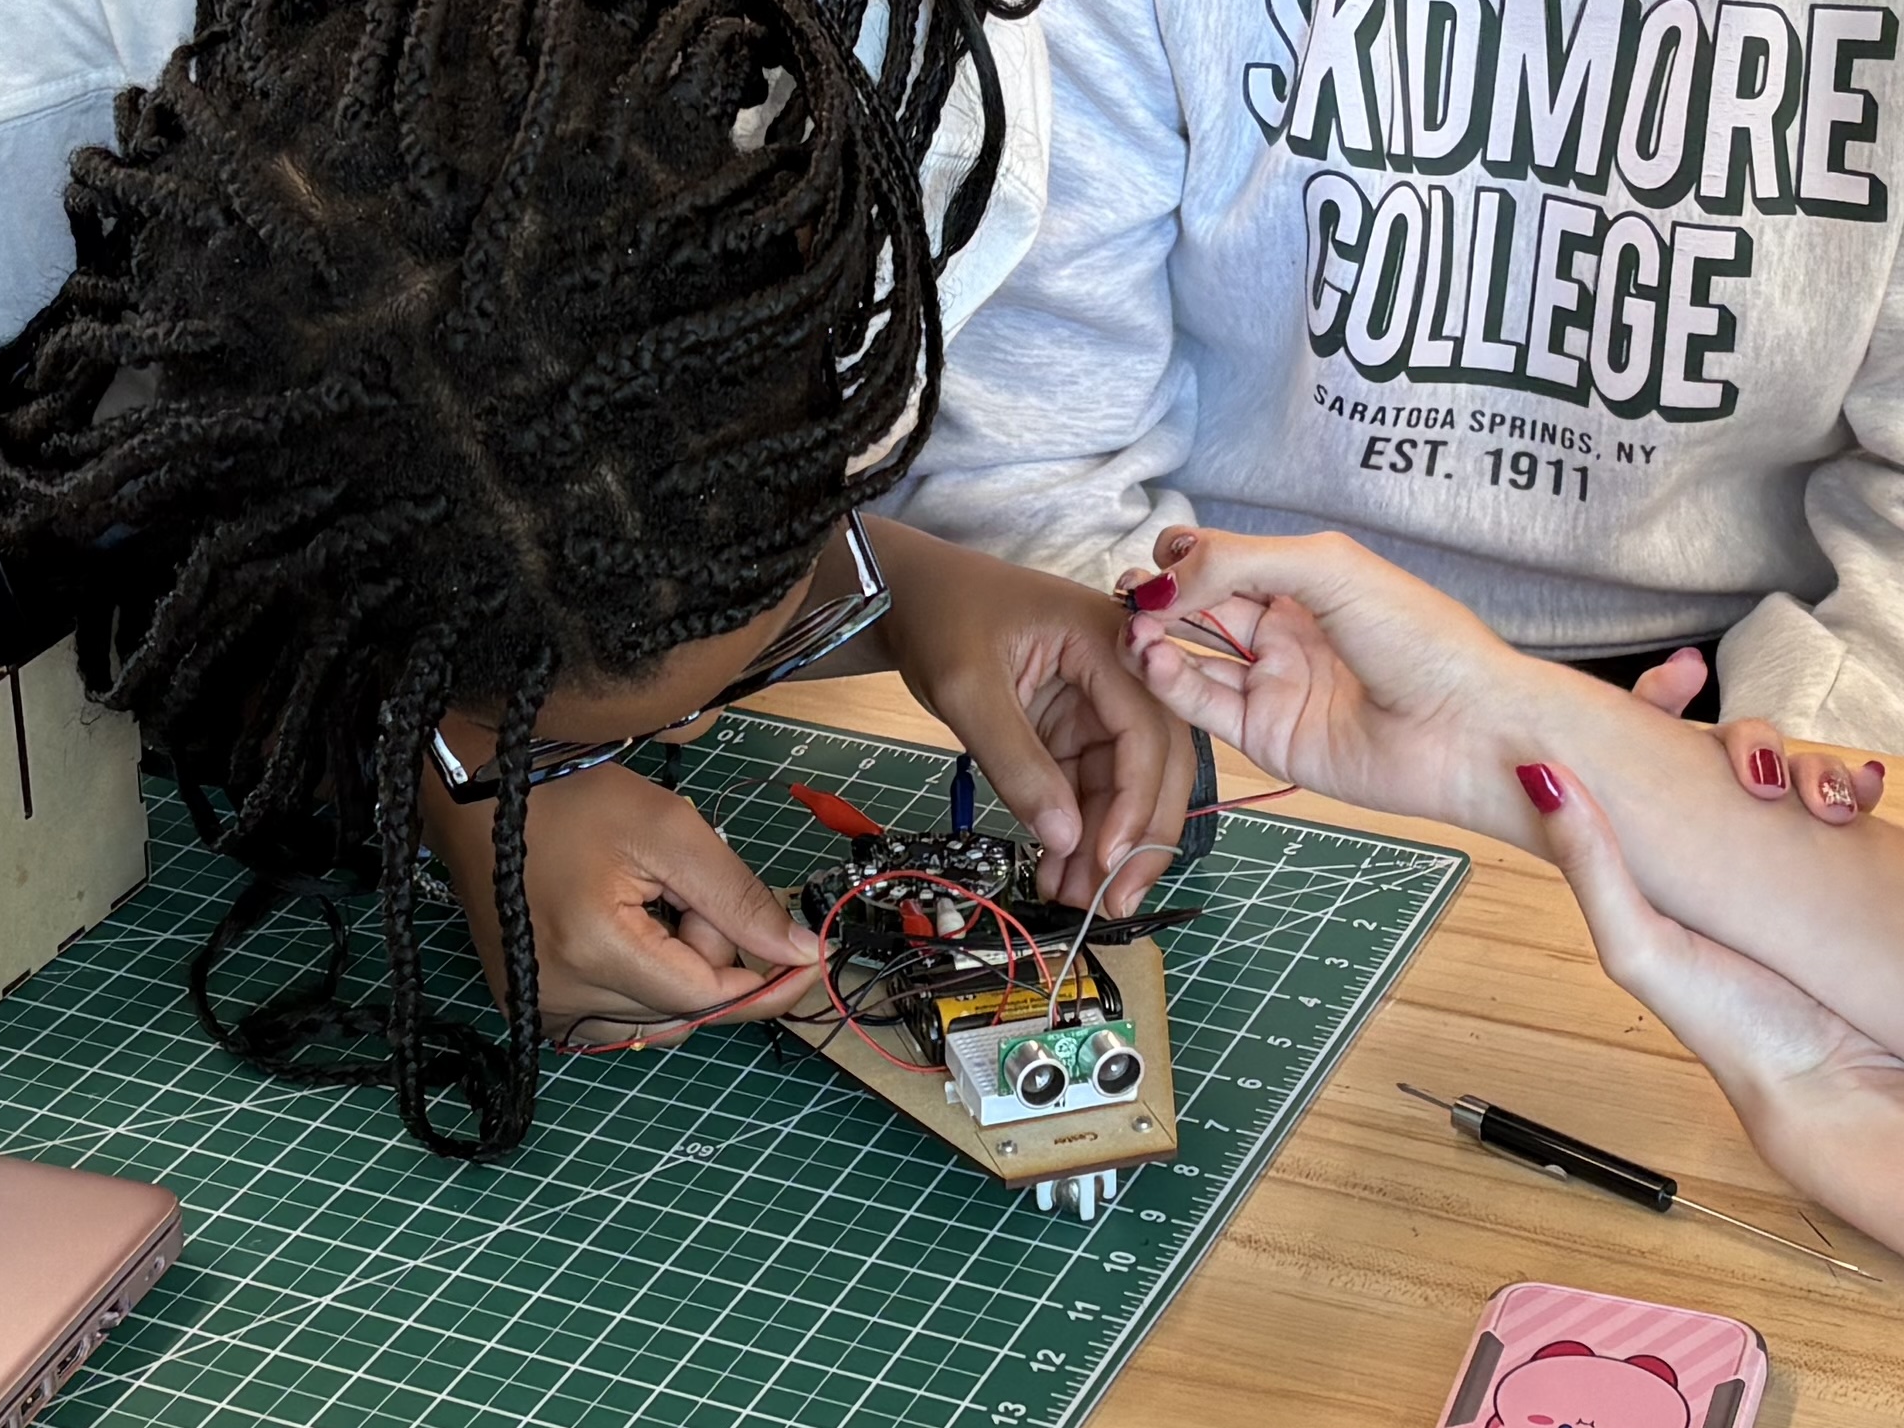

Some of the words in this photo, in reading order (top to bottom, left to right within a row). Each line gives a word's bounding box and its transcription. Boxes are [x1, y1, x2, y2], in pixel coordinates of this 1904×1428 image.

[1304, 169, 1755, 424] COLLEGE
[1312, 383, 1457, 432] SARATOGA
[1469, 409, 1602, 461] SPRINGS,
[1616, 440, 1658, 465] NY
[1360, 438, 1454, 480] EST.
[1483, 449, 1591, 503] 1911
[1352, 918, 1378, 931] 2
[1324, 957, 1349, 969] 3
[1298, 995, 1322, 1008] 4
[1266, 1035, 1292, 1048] 5
[1236, 1077, 1263, 1089] 6
[1203, 1118, 1230, 1132] 7
[1173, 1163, 1200, 1177] 8
[1139, 1209, 1167, 1223] 9
[1102, 1251, 1137, 1273] 10
[1066, 1300, 1101, 1321] 11
[1029, 1349, 1066, 1373] 12
[991, 1401, 1027, 1425] 13
